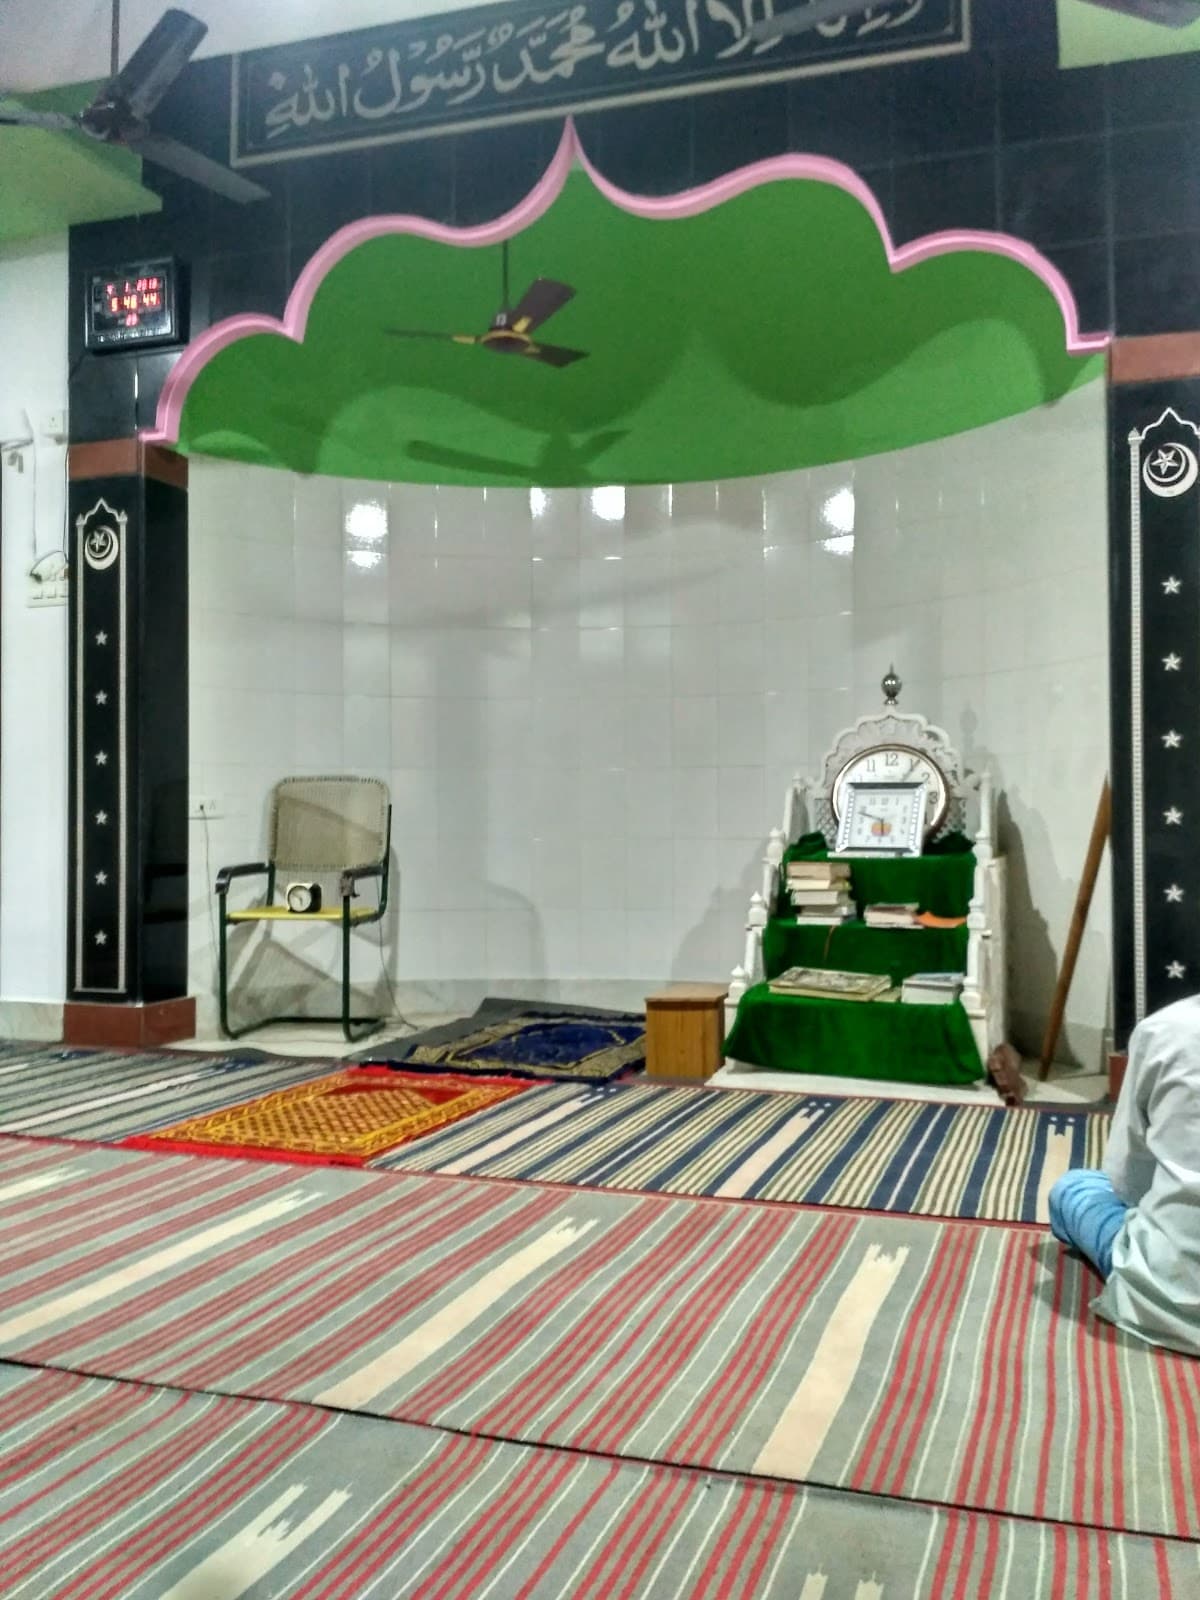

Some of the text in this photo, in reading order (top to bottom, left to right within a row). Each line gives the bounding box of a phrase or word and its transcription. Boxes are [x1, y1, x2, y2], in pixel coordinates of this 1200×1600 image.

[885, 752, 899, 766] 12
[866, 760, 876, 772] 11
[929, 791, 938, 804] 3
